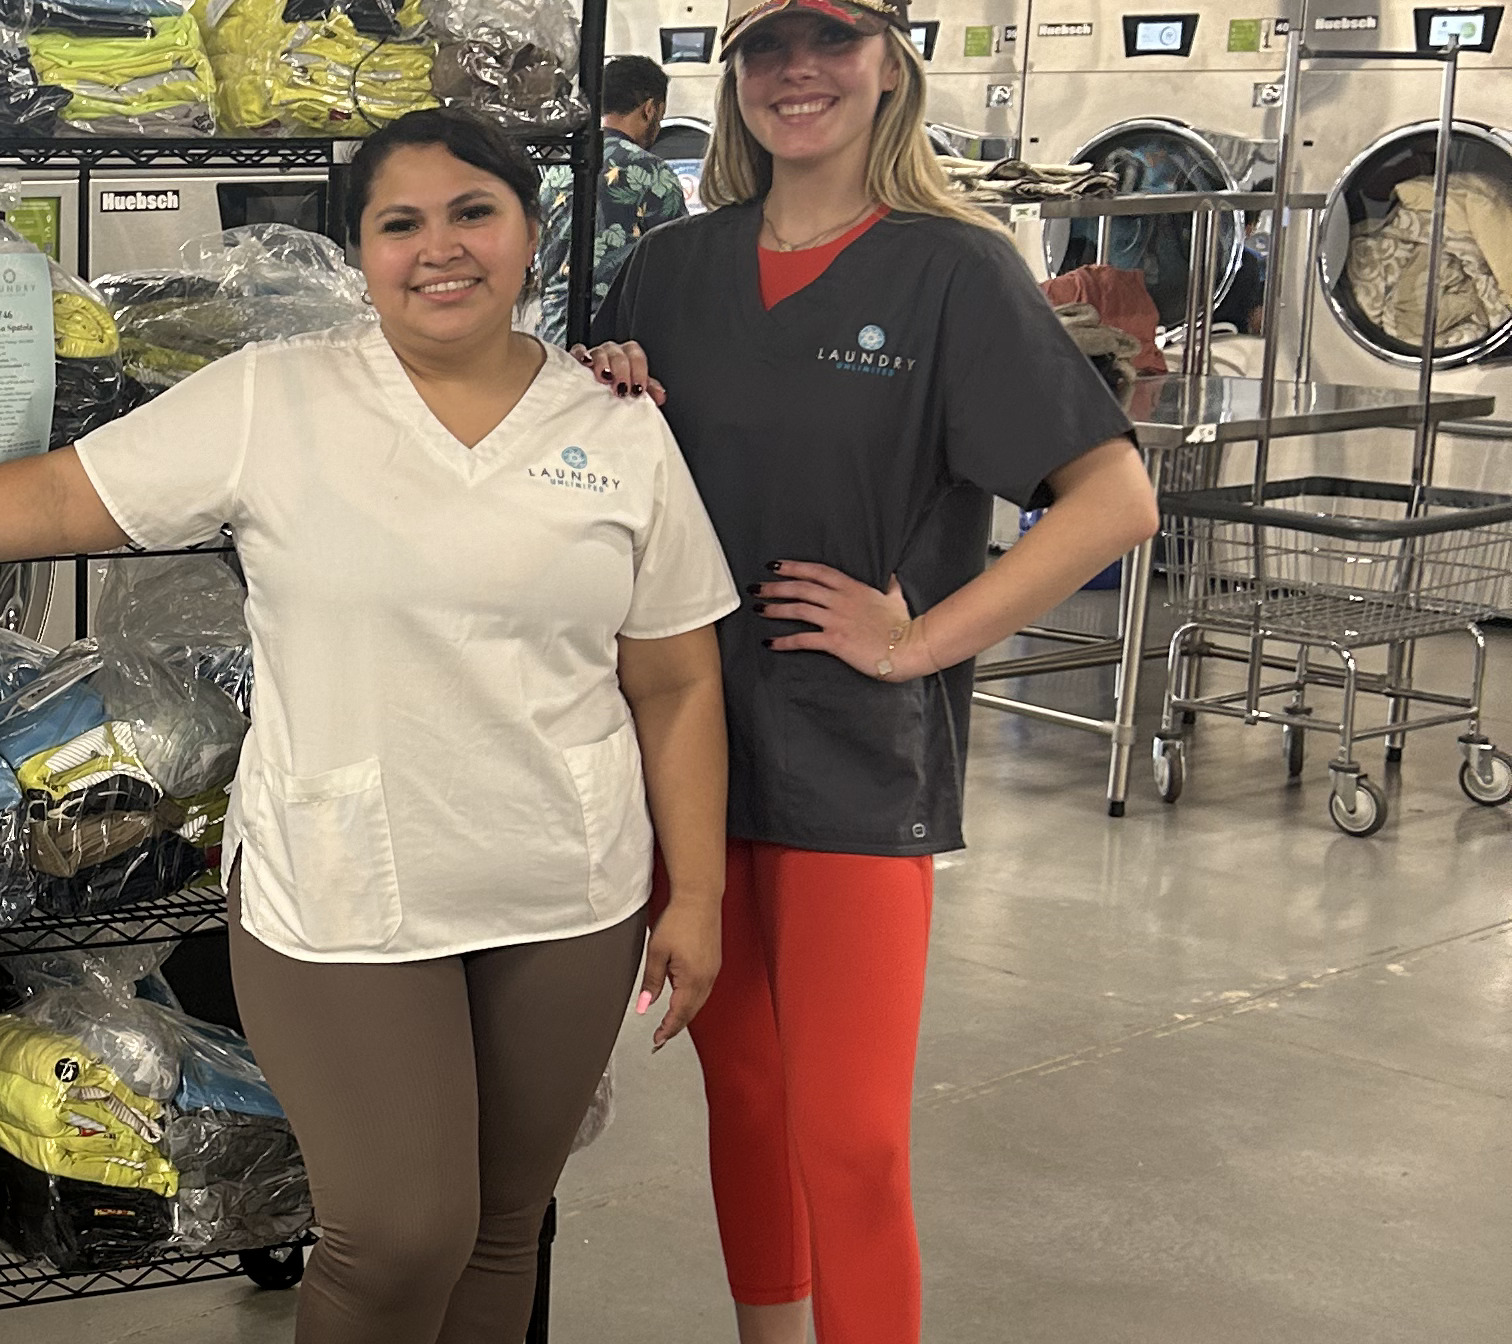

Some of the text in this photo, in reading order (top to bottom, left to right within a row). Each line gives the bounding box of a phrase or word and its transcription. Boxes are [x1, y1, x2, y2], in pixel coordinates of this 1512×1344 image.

[102, 191, 179, 211] Huebsch
[816, 347, 917, 371] LAUNDRY
[527, 466, 621, 491] LAUNDRY
